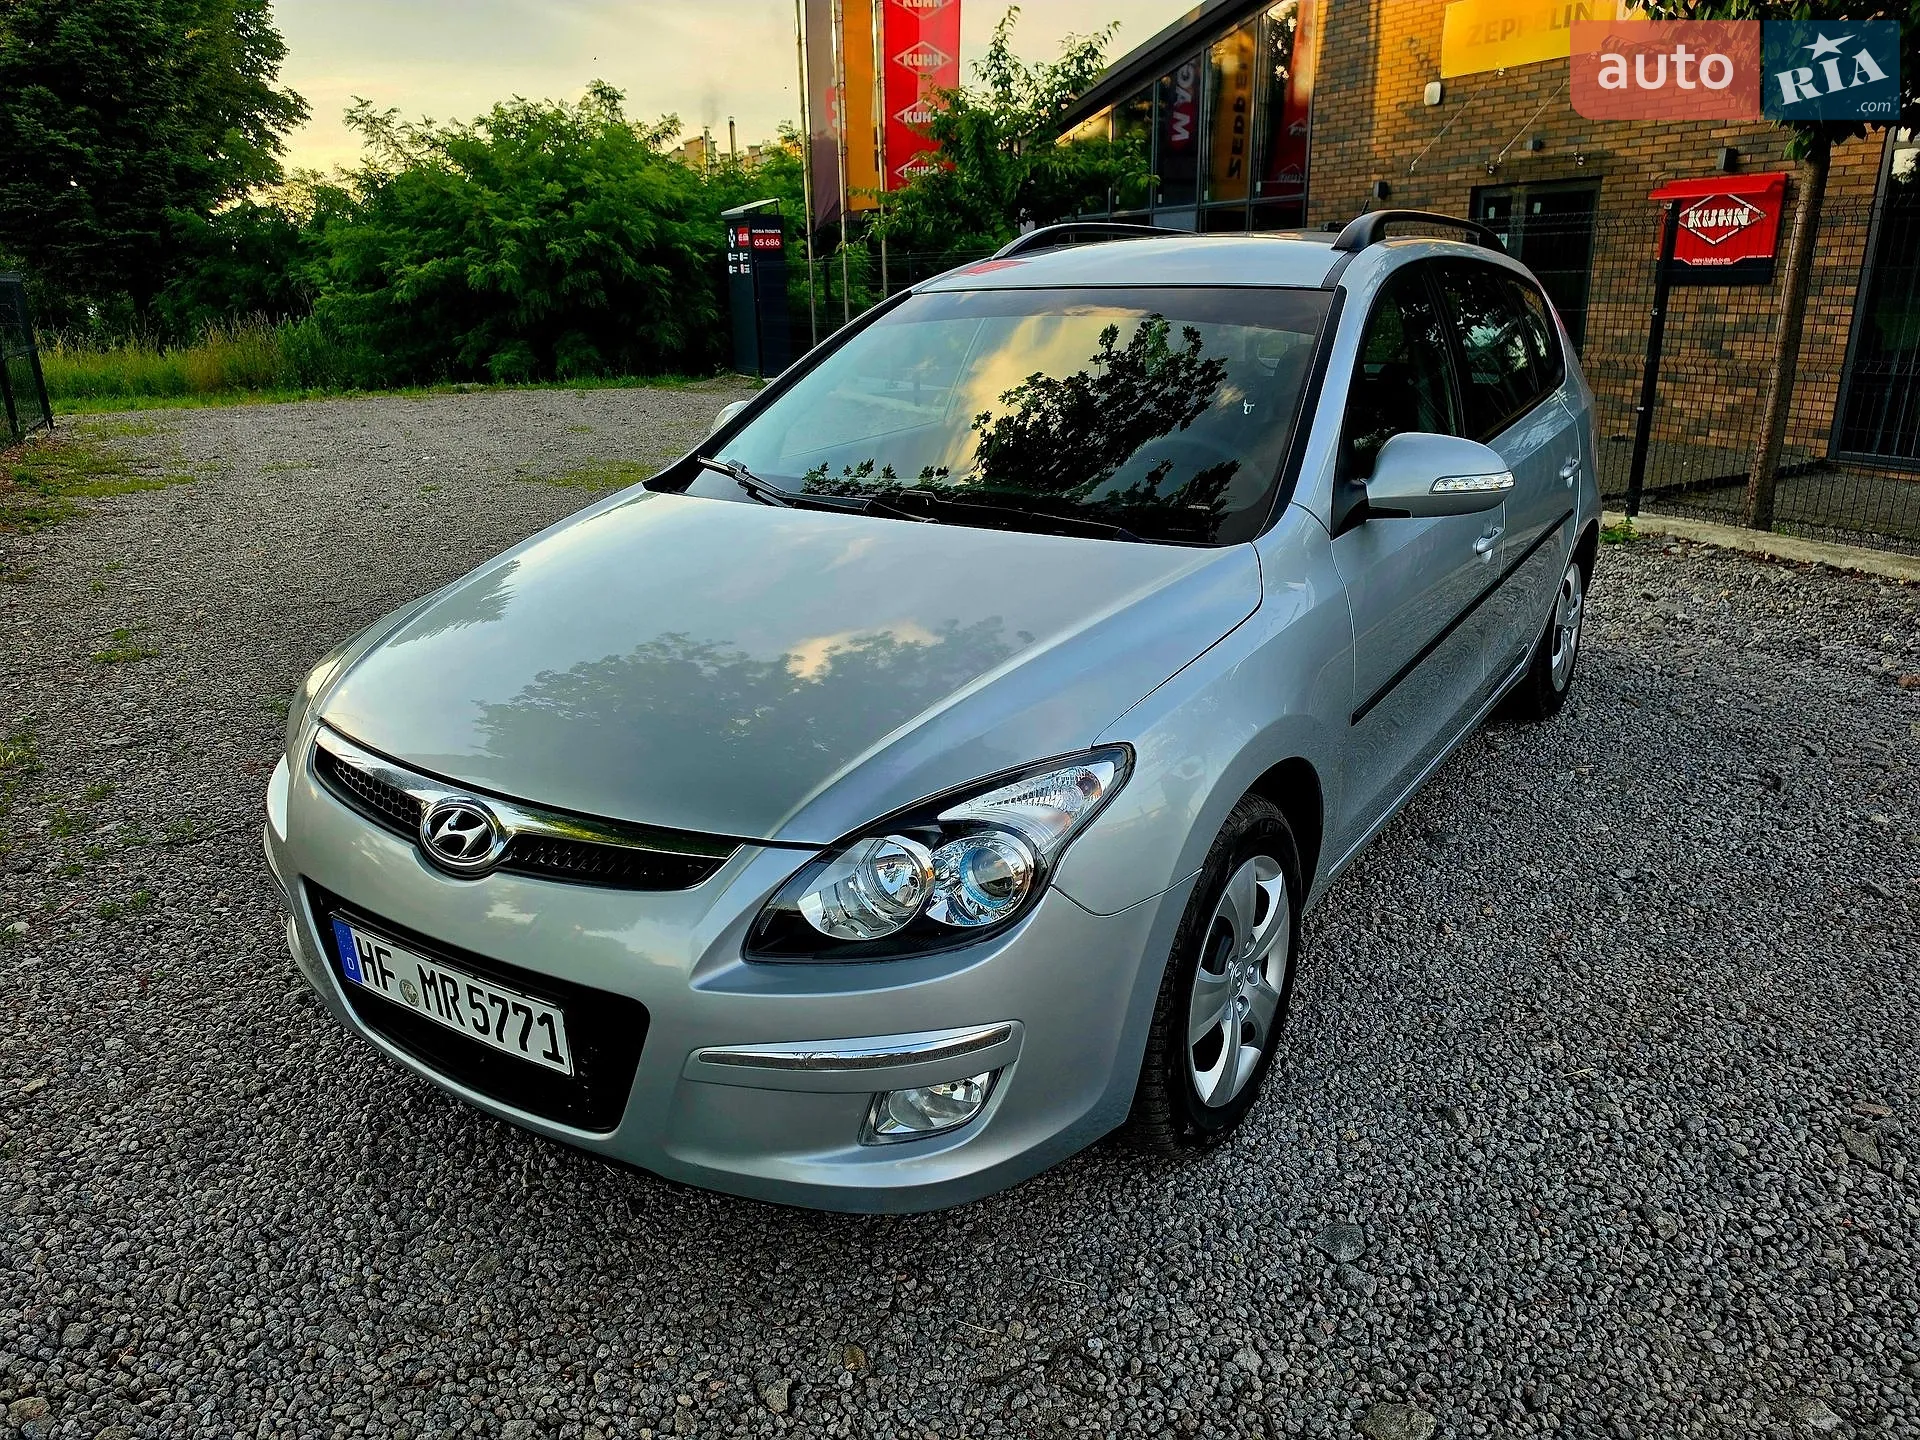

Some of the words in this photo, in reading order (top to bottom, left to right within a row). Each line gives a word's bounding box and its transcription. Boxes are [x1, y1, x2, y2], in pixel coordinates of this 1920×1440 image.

[903, 53, 942, 66] KUHN
[903, 111, 933, 123] KUH
[1687, 208, 1749, 228] KUHN
[347, 957, 355, 970] D
[356, 935, 396, 992] HF
